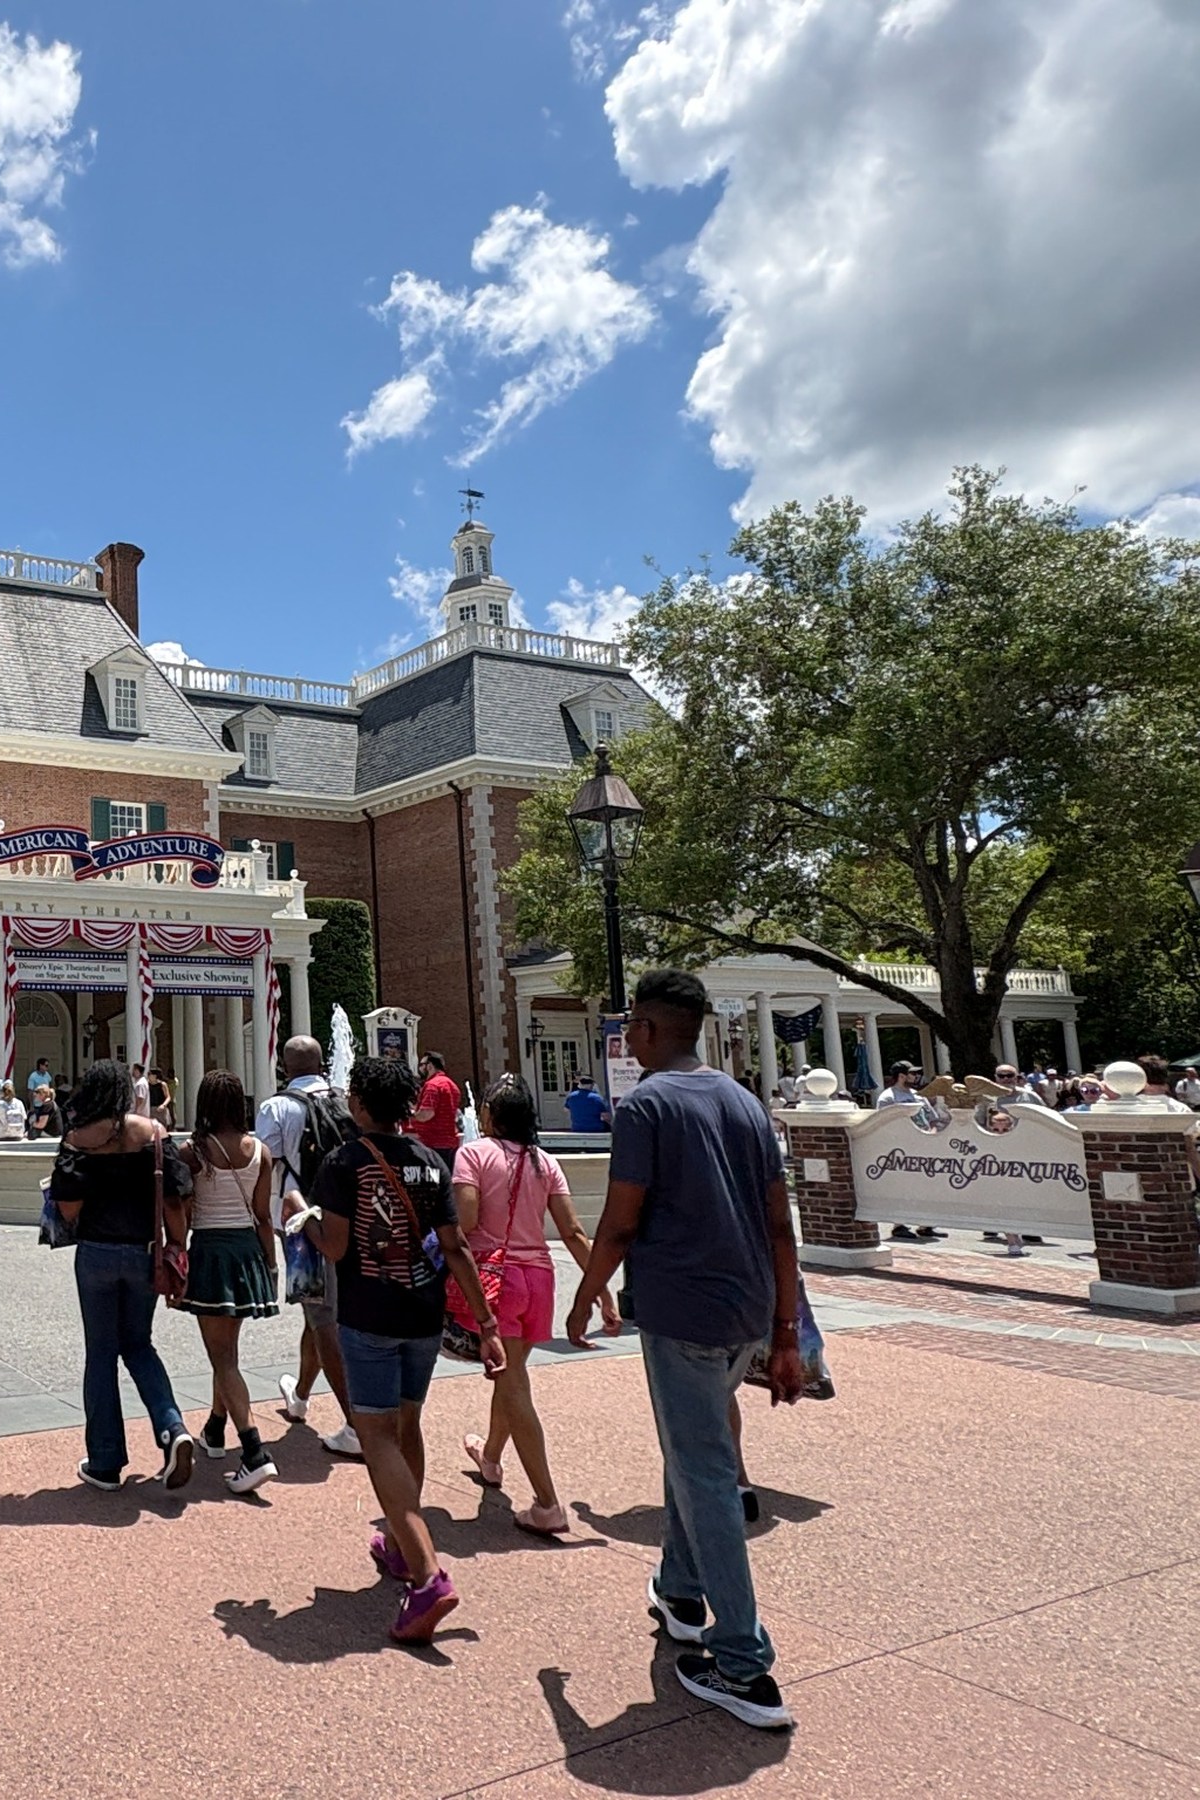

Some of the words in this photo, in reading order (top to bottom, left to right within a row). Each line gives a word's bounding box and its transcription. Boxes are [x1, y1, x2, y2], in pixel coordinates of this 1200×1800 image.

[106, 838, 208, 864] ADVENTURE
[80, 905, 193, 920] THEATRE
[48, 964, 63, 972] Epic
[65, 964, 100, 972] Theatrical
[101, 965, 121, 973] Event
[152, 969, 202, 981] Exclusive
[203, 970, 249, 985] Showing
[949, 1138, 978, 1155] The
[403, 1166, 421, 1183] SPY
